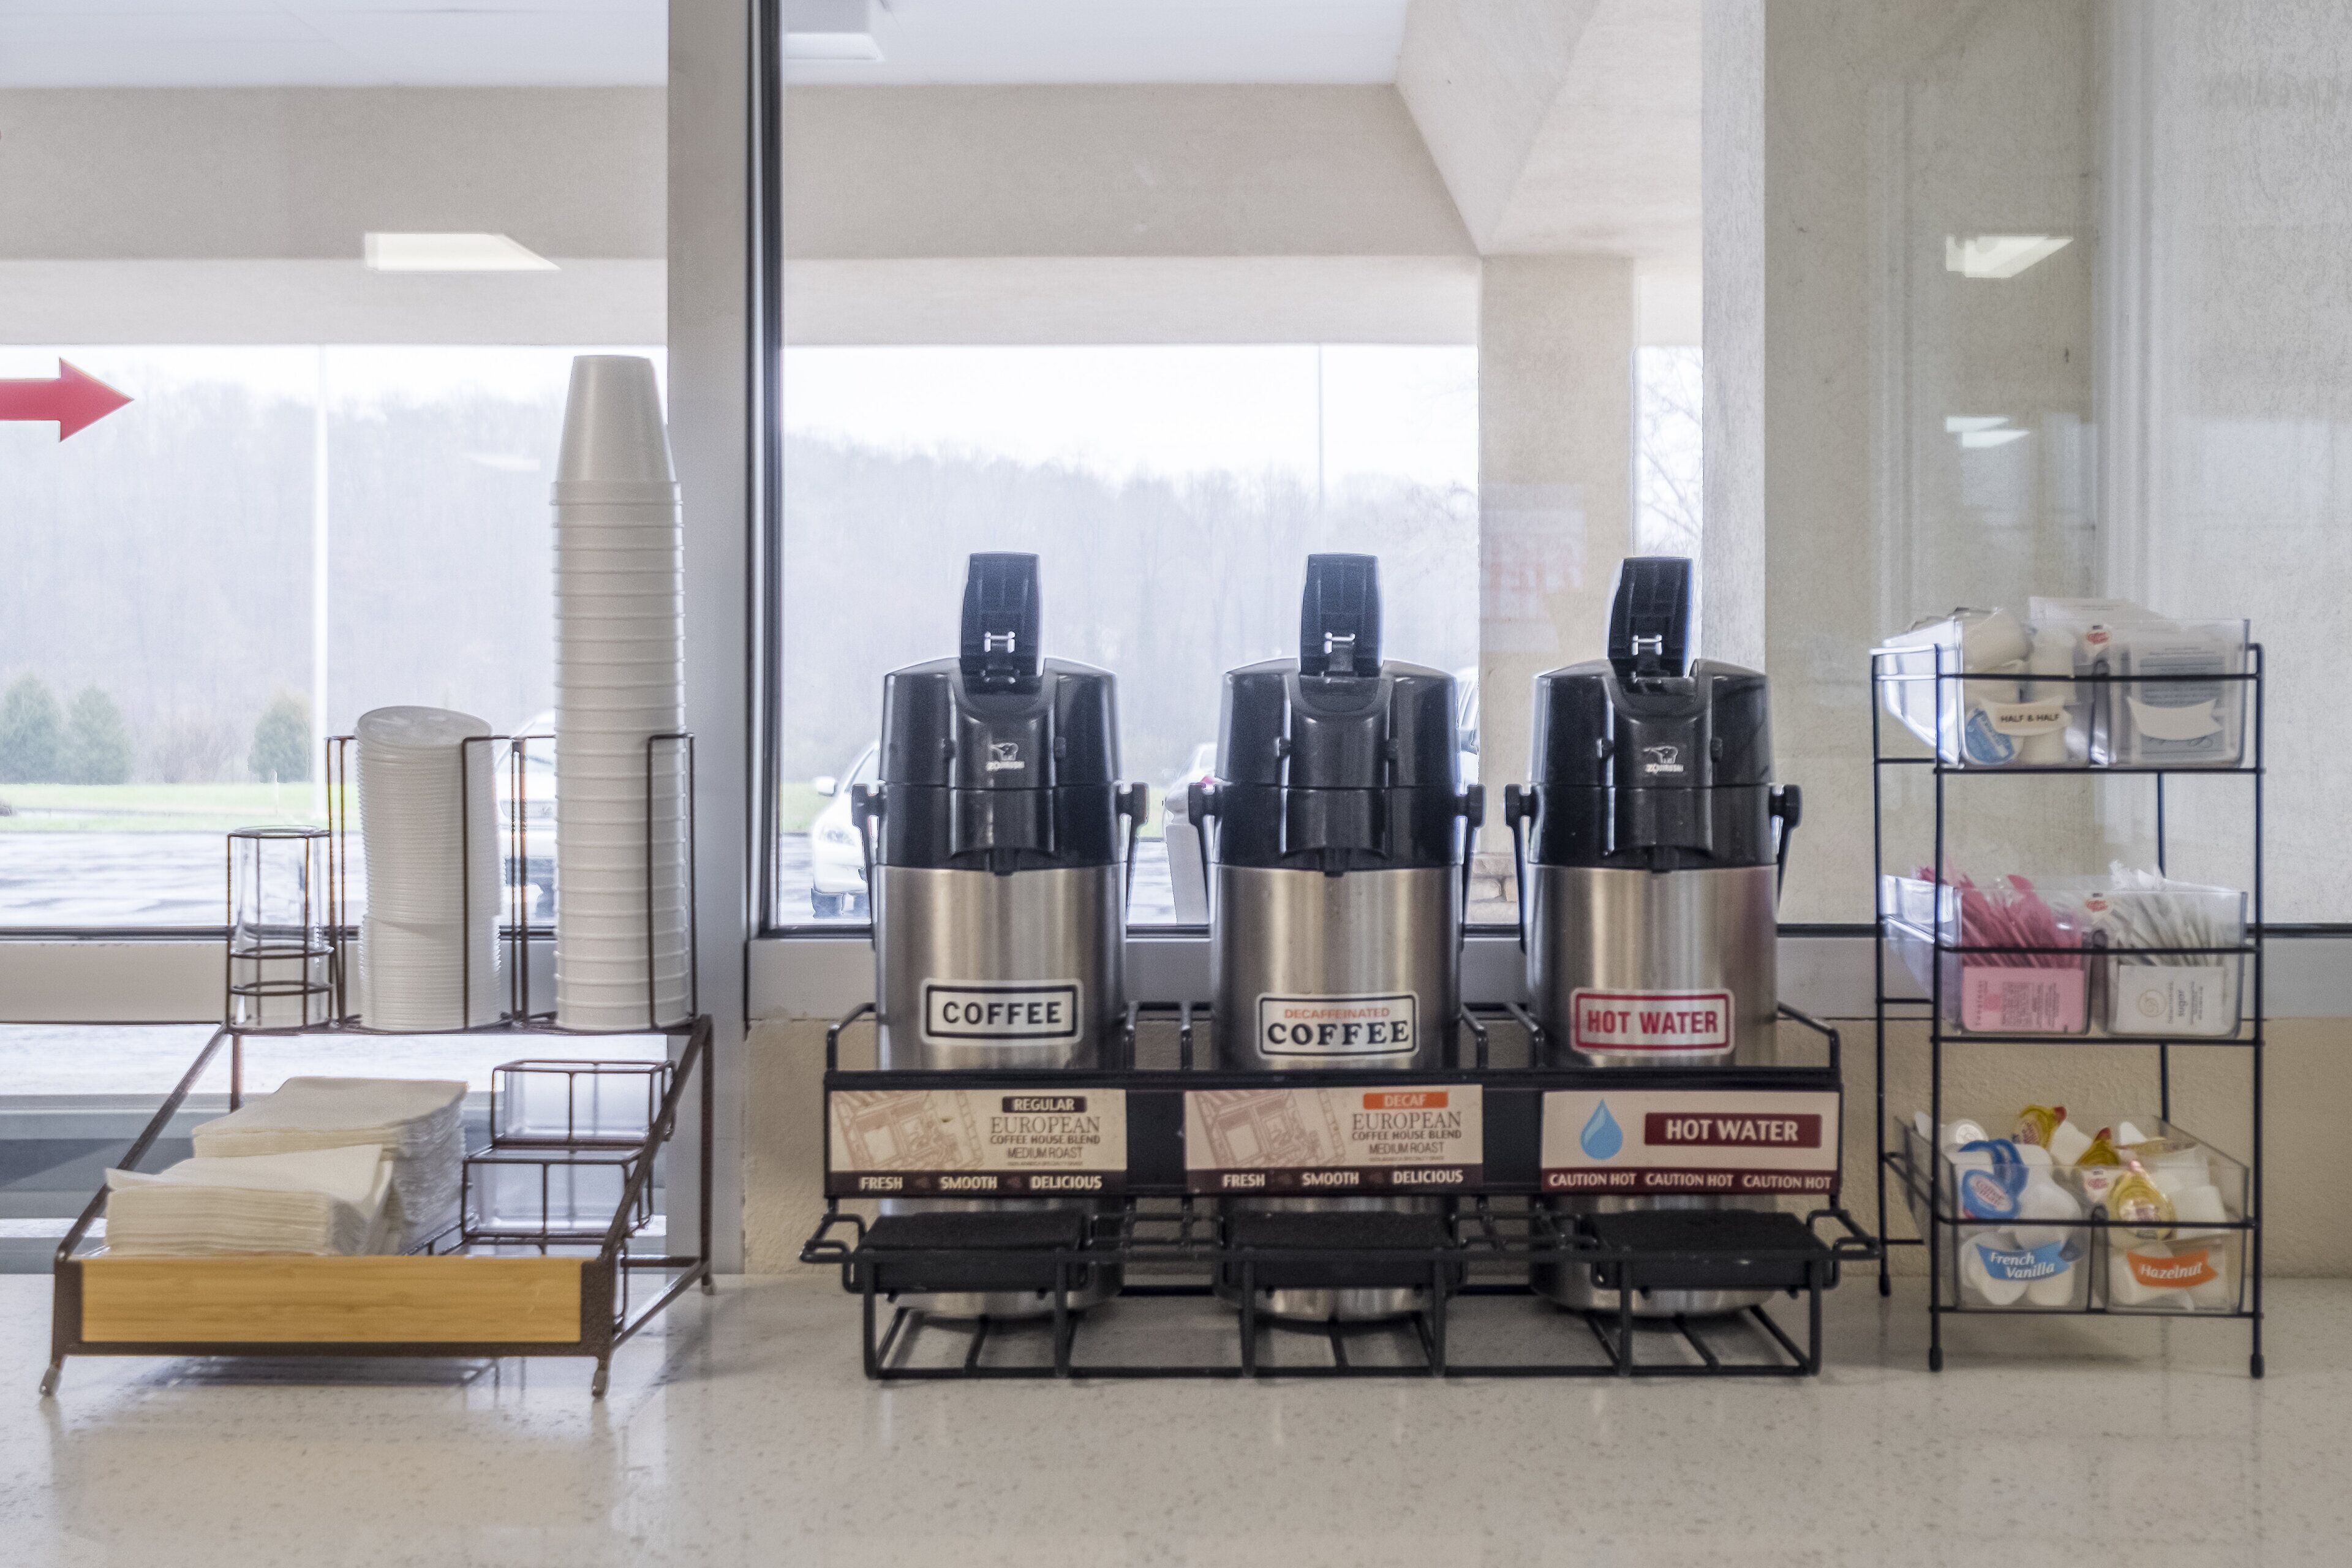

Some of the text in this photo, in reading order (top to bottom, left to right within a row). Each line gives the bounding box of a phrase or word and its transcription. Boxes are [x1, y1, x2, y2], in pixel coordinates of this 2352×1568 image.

[2000, 714, 2024, 723] HALF
[2036, 714, 2060, 722] HALF
[943, 1001, 1062, 1025] COFFEE
[1284, 1007, 1390, 1019] DECAFFEINATED
[1587, 1009, 1718, 1035] HOT WATER
[1267, 1020, 1409, 1046] COFFEE
[1014, 1098, 1075, 1111] REGULAR
[1384, 1094, 1427, 1107] DECAF
[990, 1116, 1101, 1134] EUROPEAN
[1352, 1111, 1462, 1130] EUROPEAN
[1352, 1129, 1462, 1141] COFFEE HOUSE BLEND
[1666, 1119, 1799, 1142] HOT WATER
[990, 1135, 1101, 1145] COFFEE HOUSE BLEND
[1369, 1141, 1445, 1155] MEDIUM ROAST
[1007, 1147, 1083, 1159] MEDIUM ROAST
[860, 1175, 1102, 1191] FRESH SMOOTH DELICIOUS
[1222, 1170, 1463, 1188] FRESH SMOOTH DELICIOUS
[1549, 1173, 1831, 1189] CAUTION HOT CAUTION HOT CAUTION HOT
[1990, 1251, 2035, 1265] French
[2006, 1261, 2056, 1279] Vanilla
[2140, 1261, 2203, 1279] Hazelnut
